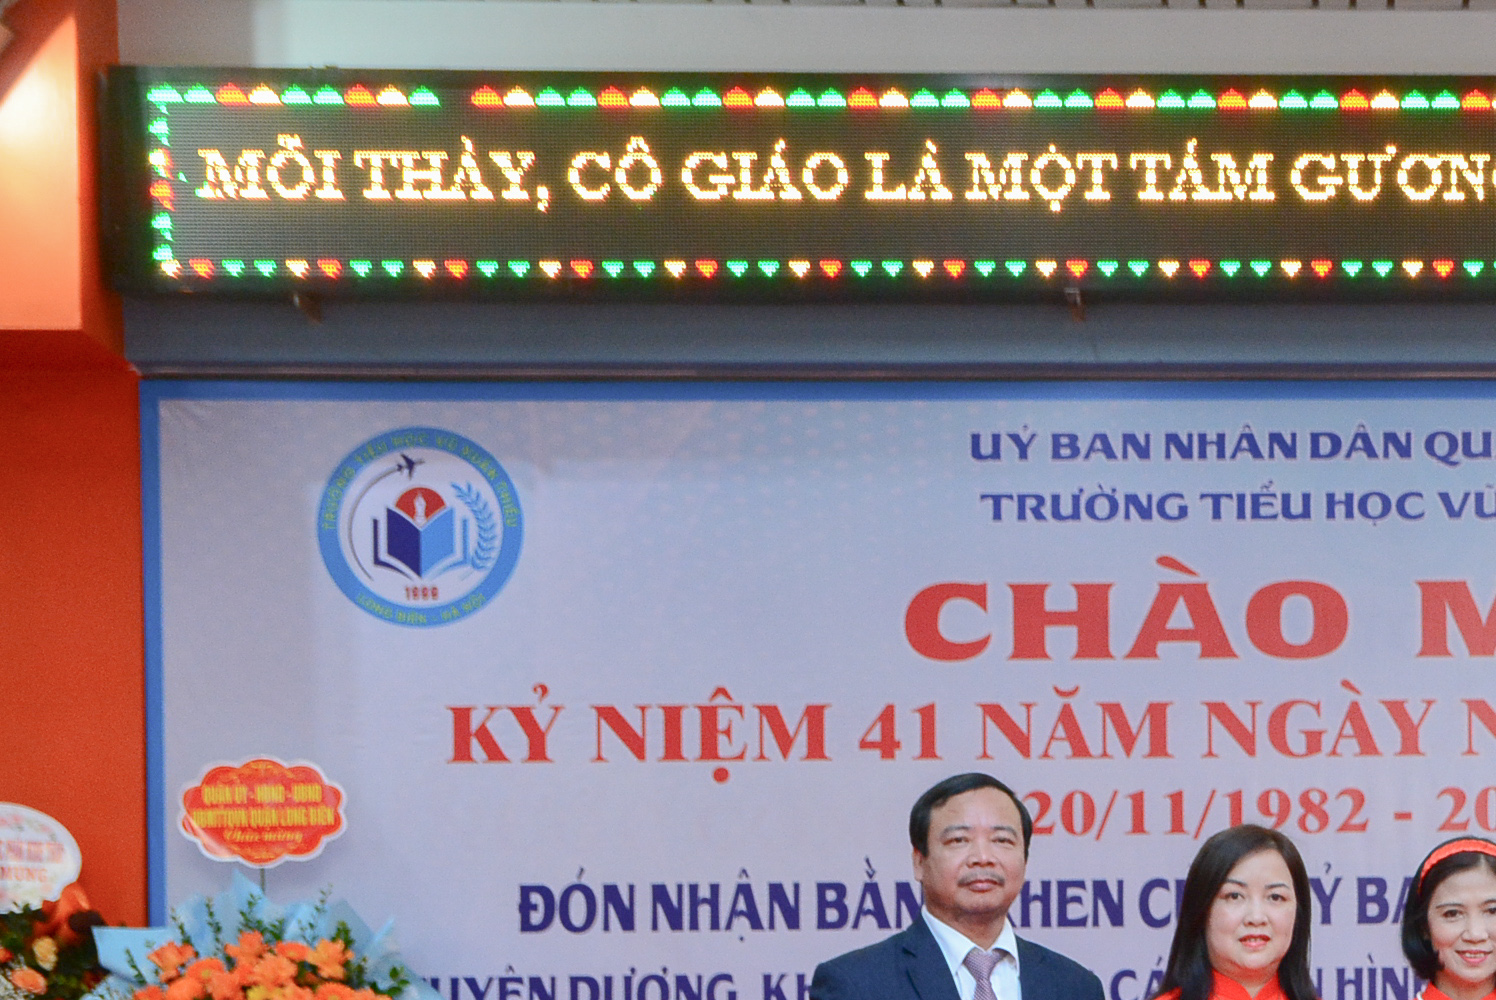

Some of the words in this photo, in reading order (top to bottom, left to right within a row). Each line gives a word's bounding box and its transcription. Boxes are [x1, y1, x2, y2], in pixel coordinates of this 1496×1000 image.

[567, 136, 662, 201] CÔ
[681, 139, 849, 201] GIÁO
[864, 139, 953, 201] LÀ
[1051, 432, 1151, 461] BAN
[1164, 424, 1298, 461] NHÂN
[1309, 424, 1412, 460] DÂN
[980, 484, 1189, 522] TRƯỜNG
[1325, 491, 1426, 527] HỌC
[905, 555, 1349, 662] CHÀO
[447, 683, 565, 763] KỶ
[591, 686, 831, 784] NIỆM
[858, 702, 943, 761] 41
[977, 685, 1174, 760] NĂM
[1200, 678, 1436, 759] NGÀY
[1022, 787, 1370, 841] 20/11/1982
[518, 867, 636, 933] ĐÓN
[650, 867, 802, 942] NHẬN
[815, 855, 925, 930] BẰN
[1005, 877, 1125, 930] HEN
[1310, 861, 1343, 925] Ỷ
